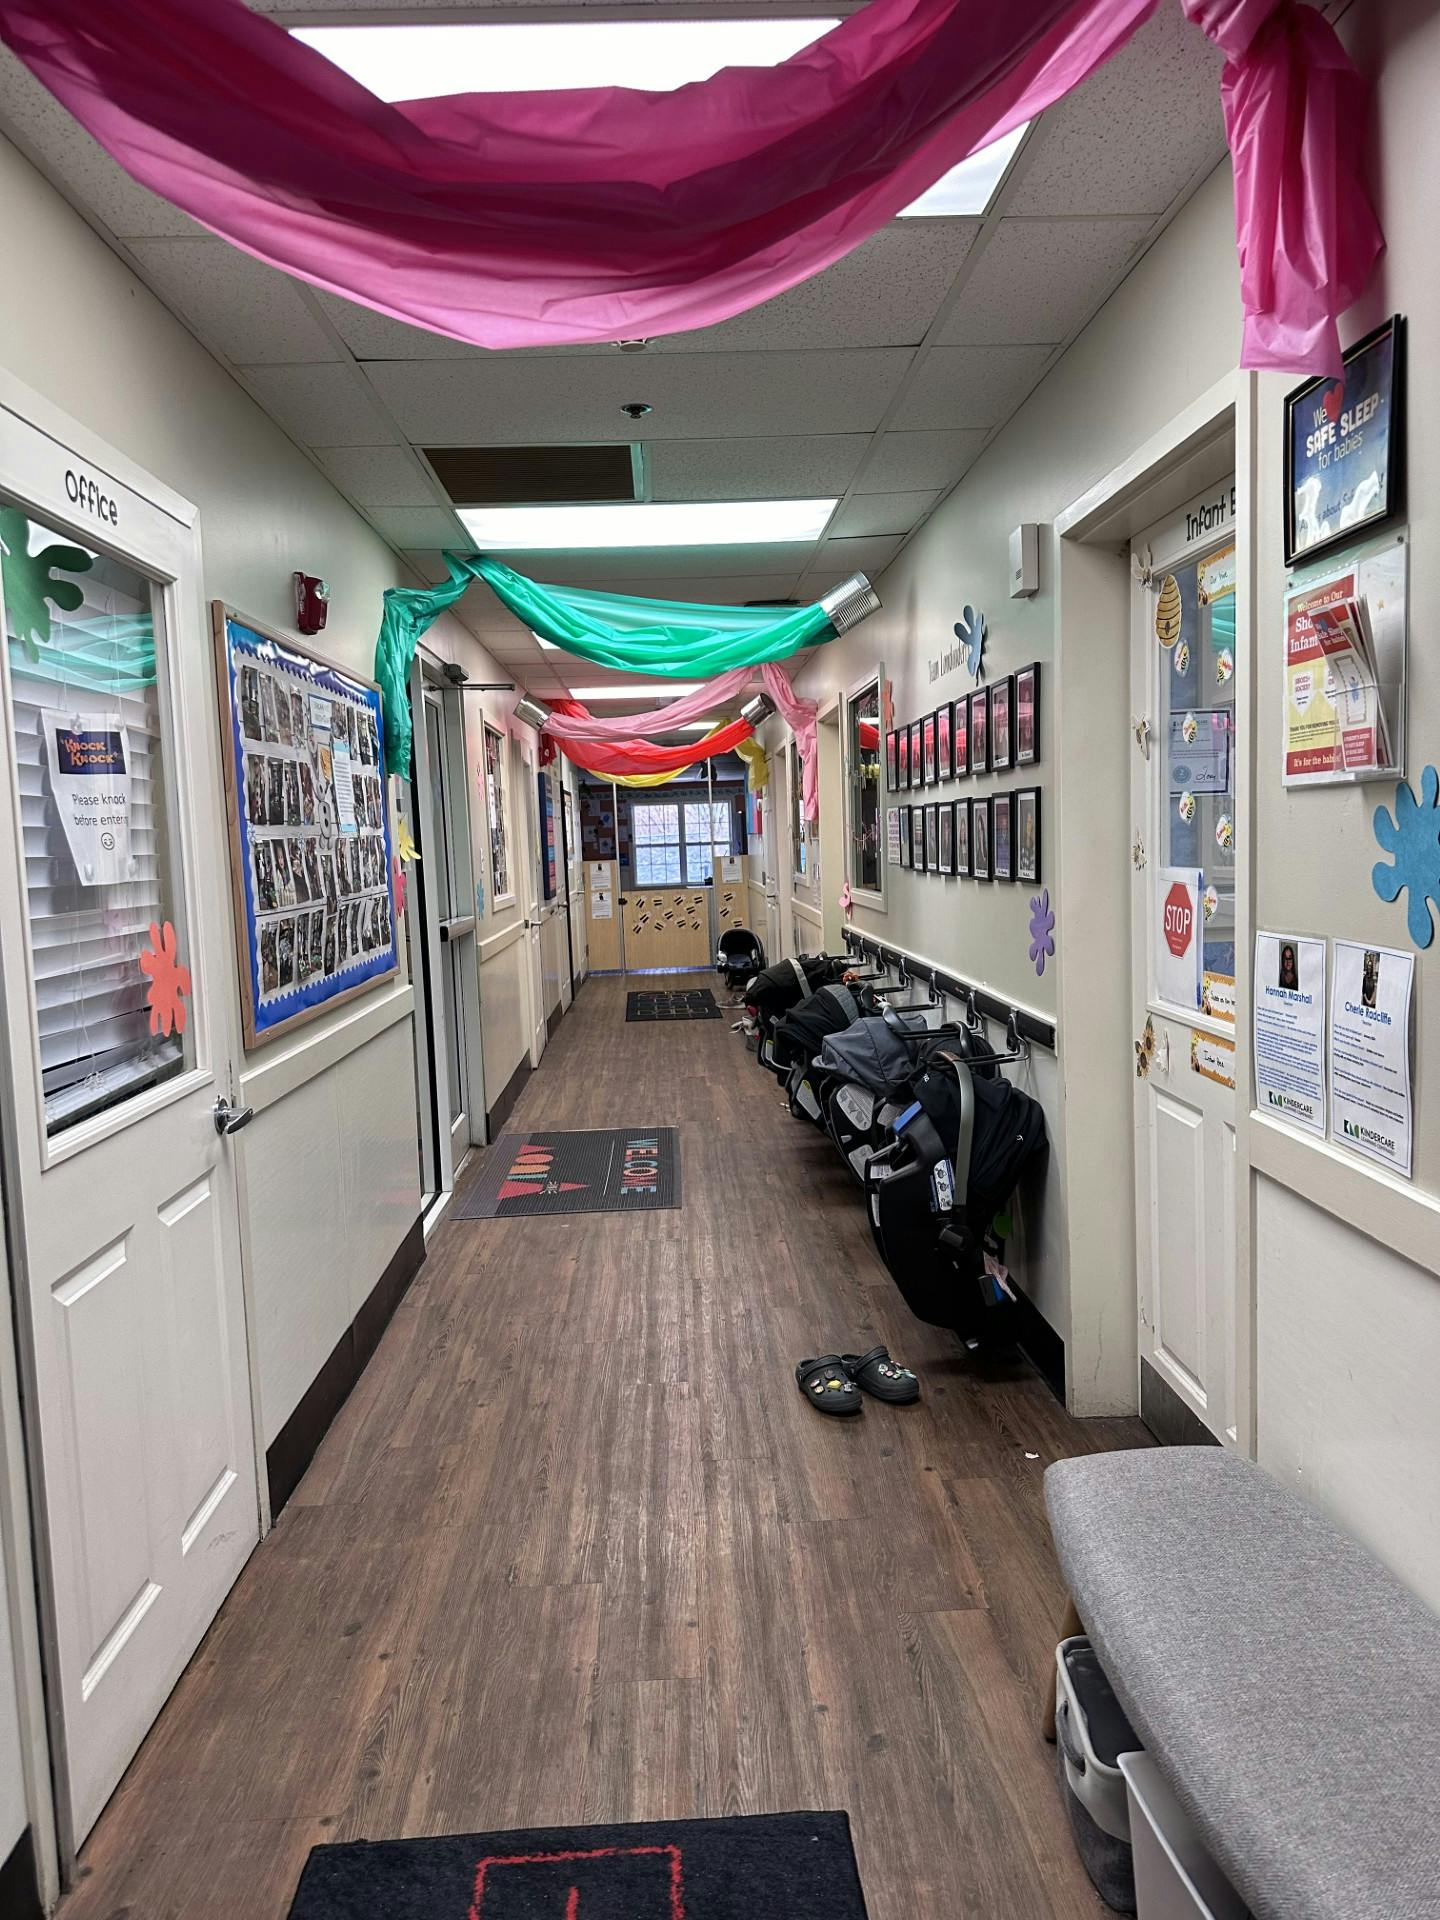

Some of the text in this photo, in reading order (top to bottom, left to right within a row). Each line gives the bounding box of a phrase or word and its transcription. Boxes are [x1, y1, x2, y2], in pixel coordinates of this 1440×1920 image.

[1306, 392, 1379, 457] SAFE SLEEP
[1313, 407, 1328, 428] We
[1319, 431, 1364, 470] for babies
[65, 469, 118, 526] Office
[1186, 494, 1226, 541] Infant
[1297, 590, 1343, 613] Welcome to Our
[1290, 635, 1319, 653] Infant
[1293, 758, 1302, 767] It's
[1303, 757, 1311, 766] for
[1312, 756, 1321, 765] the
[72, 793, 126, 806] Please knock
[74, 814, 98, 826] before
[1165, 904, 1191, 936] STOP
[1265, 985, 1312, 1004] Hannah Marshall
[1365, 1007, 1392, 1025] Radcliffe
[1284, 1096, 1313, 1115] KINDERCARE
[1360, 1126, 1395, 1150] KINDERCARE
[620, 1138, 658, 1195] WELCOME
